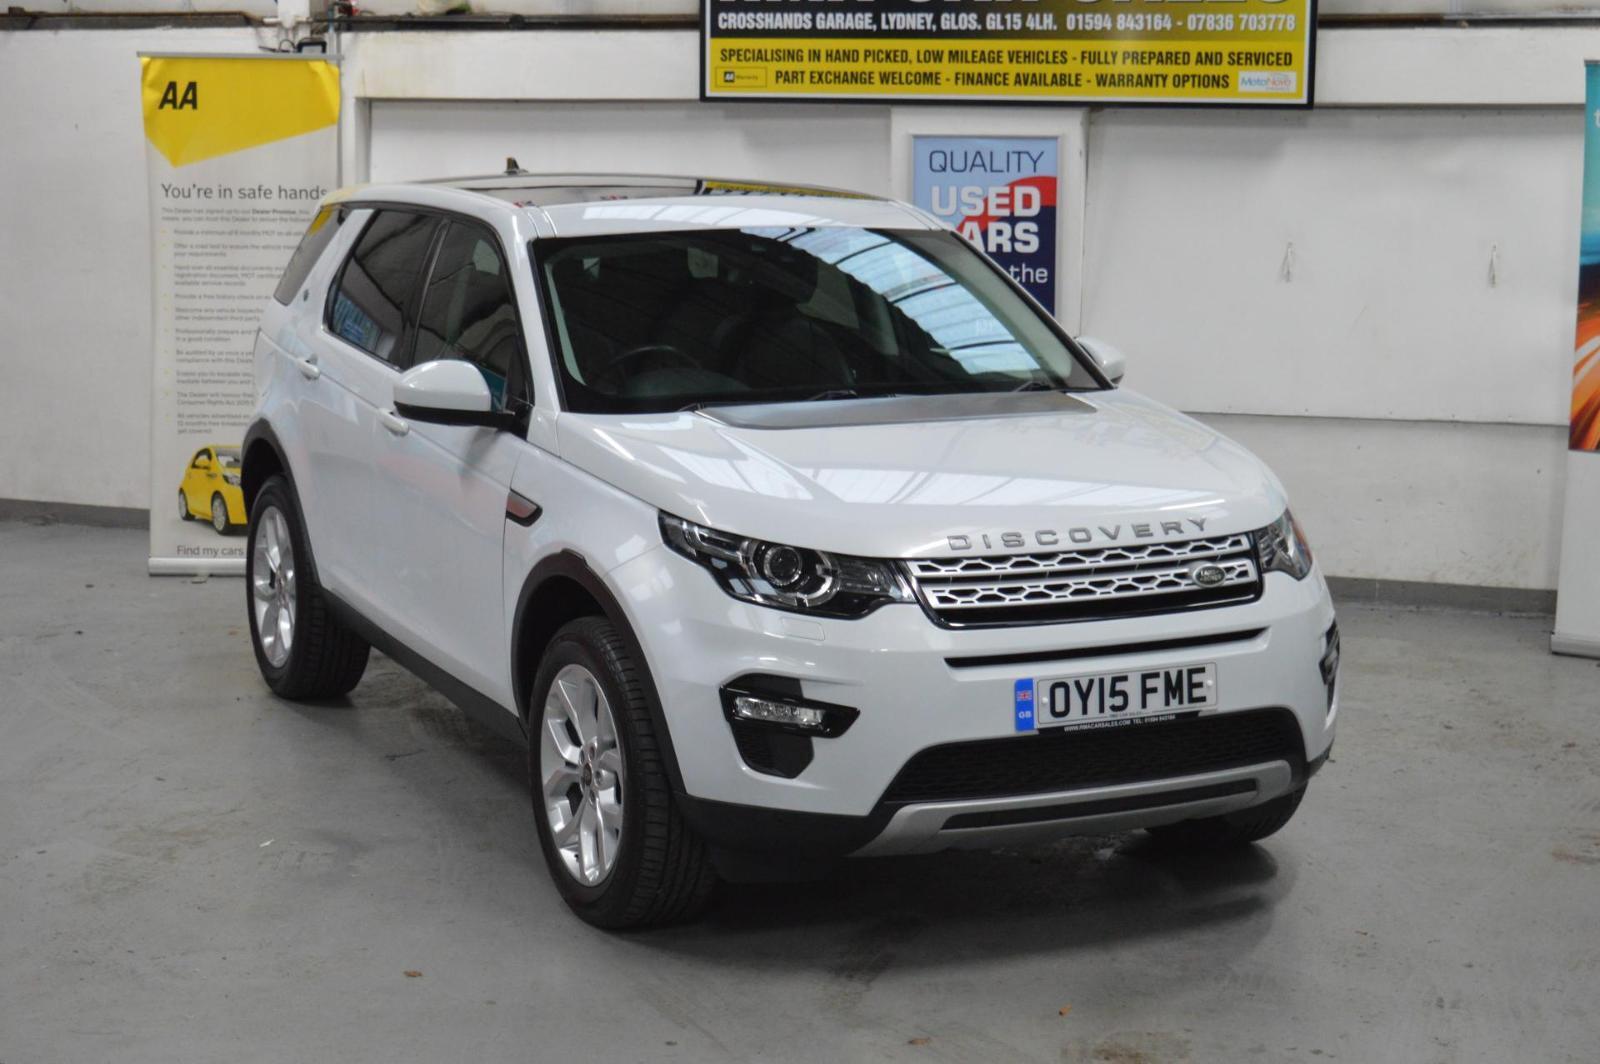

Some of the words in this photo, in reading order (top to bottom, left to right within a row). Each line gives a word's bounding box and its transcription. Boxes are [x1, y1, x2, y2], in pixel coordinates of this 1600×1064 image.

[718, 12, 812, 30] CROSSHANDS
[815, 13, 877, 31] GARAGE,
[881, 13, 937, 31] LYDNEY,
[940, 13, 982, 30] GLOS.
[986, 13, 1021, 30] GL15
[1026, 13, 1057, 30] 4LH.
[1066, 13, 1112, 31] 01594
[1116, 13, 1172, 31] 843164
[1187, 13, 1234, 31] 07836
[1239, 13, 1296, 31] 703778
[720, 48, 804, 63] SPECIALISING
[808, 49, 821, 63] IN
[825, 49, 859, 63] HAND
[863, 49, 912, 64] PICKED,
[916, 49, 944, 63] LOW
[948, 49, 1003, 64] MILEAGE
[1007, 50, 1068, 64] VEHICLES
[1080, 51, 1117, 65] FULLY
[1122, 51, 1191, 66] PREPARED
[1195, 51, 1223, 66] AND
[1227, 52, 1292, 66] SERVICED
[775, 70, 805, 84] PART
[809, 71, 875, 85] EXCHANGE
[879, 71, 941, 86] WELCOME
[954, 72, 1010, 86] FINANCE
[1013, 72, 1082, 87] AVAILABLE
[1095, 73, 1168, 88] WARRANTY
[1172, 74, 1229, 88] OPTIONS
[158, 81, 198, 110] AA
[929, 150, 1044, 174] QUALITY
[161, 183, 213, 199] You're
[218, 184, 233, 199] in
[238, 184, 273, 200] safe
[931, 186, 1041, 217] USED
[948, 221, 1040, 253] ARS
[1008, 263, 1048, 283] the
[947, 517, 1207, 551] DISCOVERY
[176, 545, 200, 555] Find
[202, 548, 218, 558] my
[221, 547, 244, 556] cars
[1049, 674, 1129, 719] OY15
[1140, 666, 1207, 709] FME
[1018, 711, 1032, 719] GB
